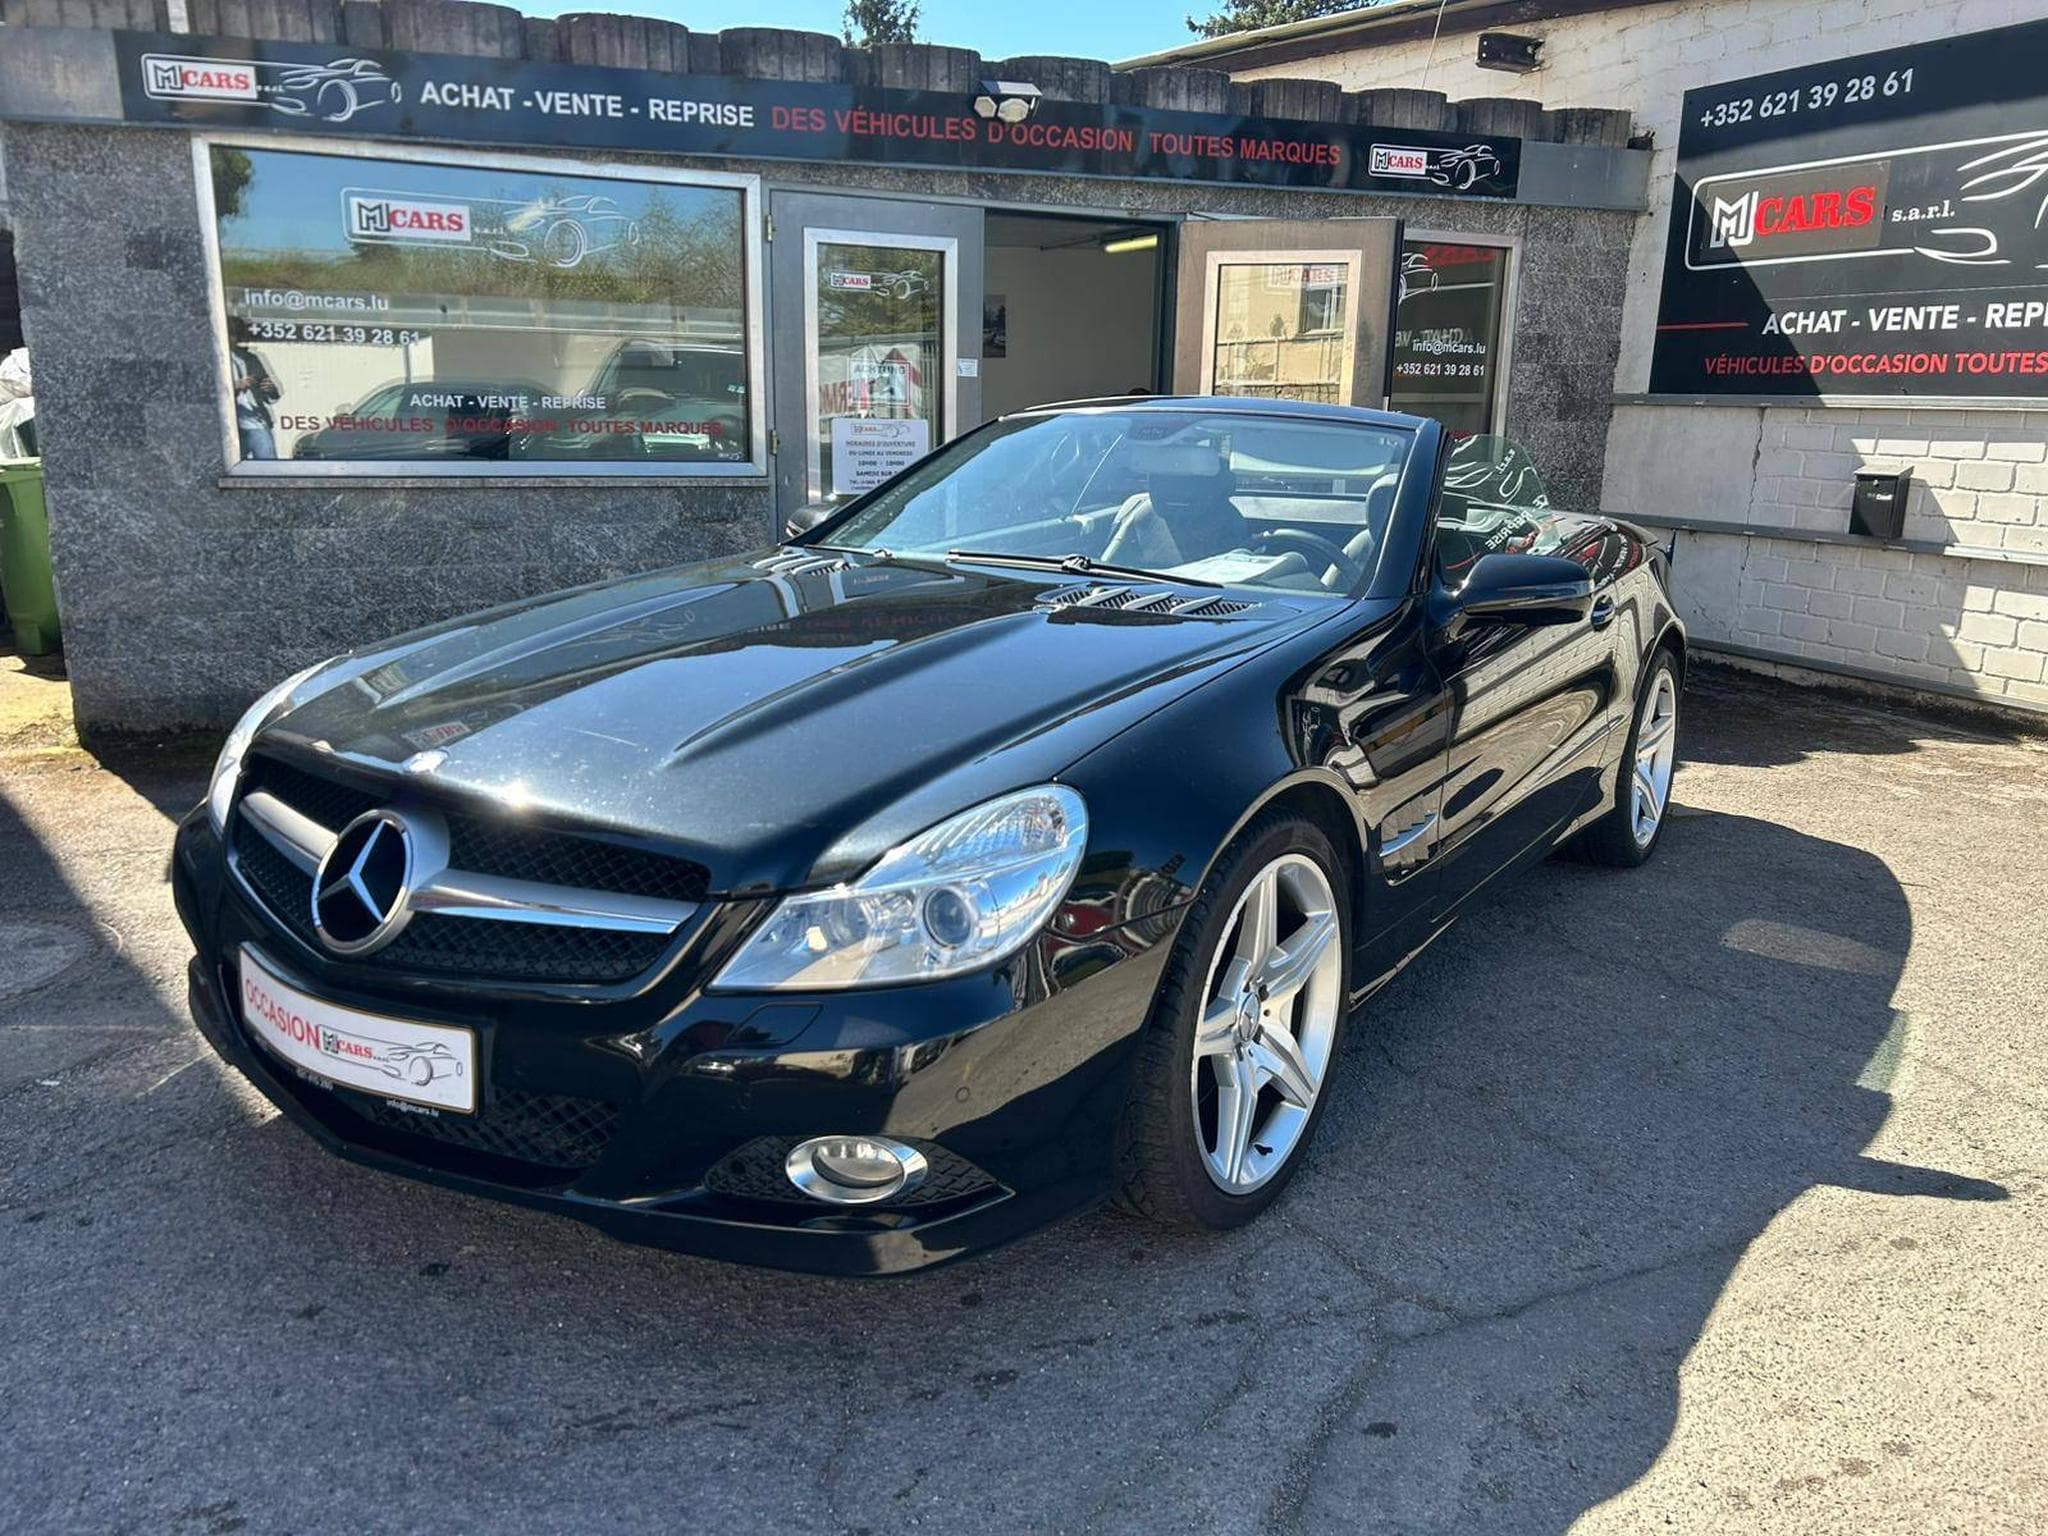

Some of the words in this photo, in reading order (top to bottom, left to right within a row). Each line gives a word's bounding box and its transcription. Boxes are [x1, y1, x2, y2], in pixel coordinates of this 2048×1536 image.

[1700, 98, 1754, 127] +352
[1759, 88, 1800, 118] 621
[1807, 82, 1839, 109] 39
[1844, 75, 1876, 103] 28
[1882, 67, 1914, 96] 61
[420, 81, 515, 111] ACHAT
[649, 98, 755, 127] REPRISE
[771, 106, 827, 132] DES
[834, 104, 977, 141] VÉHICULES
[987, 121, 1134, 152] D'OCCASION
[1150, 131, 1234, 159] TOUTES
[1239, 139, 1342, 166] MARQUES
[1891, 199, 1956, 222] s.a.r.l.
[243, 288, 390, 310] info@mcars.lu
[1761, 309, 1847, 335] ACHAT
[1868, 304, 1960, 332] VENTE
[248, 322, 297, 340] +352
[302, 324, 336, 341] 621
[342, 327, 366, 343] 39
[371, 328, 394, 344] 28
[399, 330, 420, 346] 61
[1412, 339, 1487, 356] info@mcars.lu
[1396, 362, 1421, 375] +352
[1424, 363, 1441, 375] 621
[1444, 364, 1457, 376] 39
[1458, 364, 1472, 376] 28
[1472, 365, 1485, 376] 61
[1704, 352, 1805, 375] VÉHICULES
[1808, 352, 1948, 375] D'OCCASION
[1953, 351, 2048, 374] TOUTES
[410, 393, 464, 408] ACHAT
[477, 395, 529, 409] VENTE
[541, 396, 607, 409] REPRISE
[280, 415, 320, 431] DES
[568, 419, 636, 435] TOUTES
[640, 420, 723, 436] MARQUES
[245, 978, 321, 1051] OCCASION
